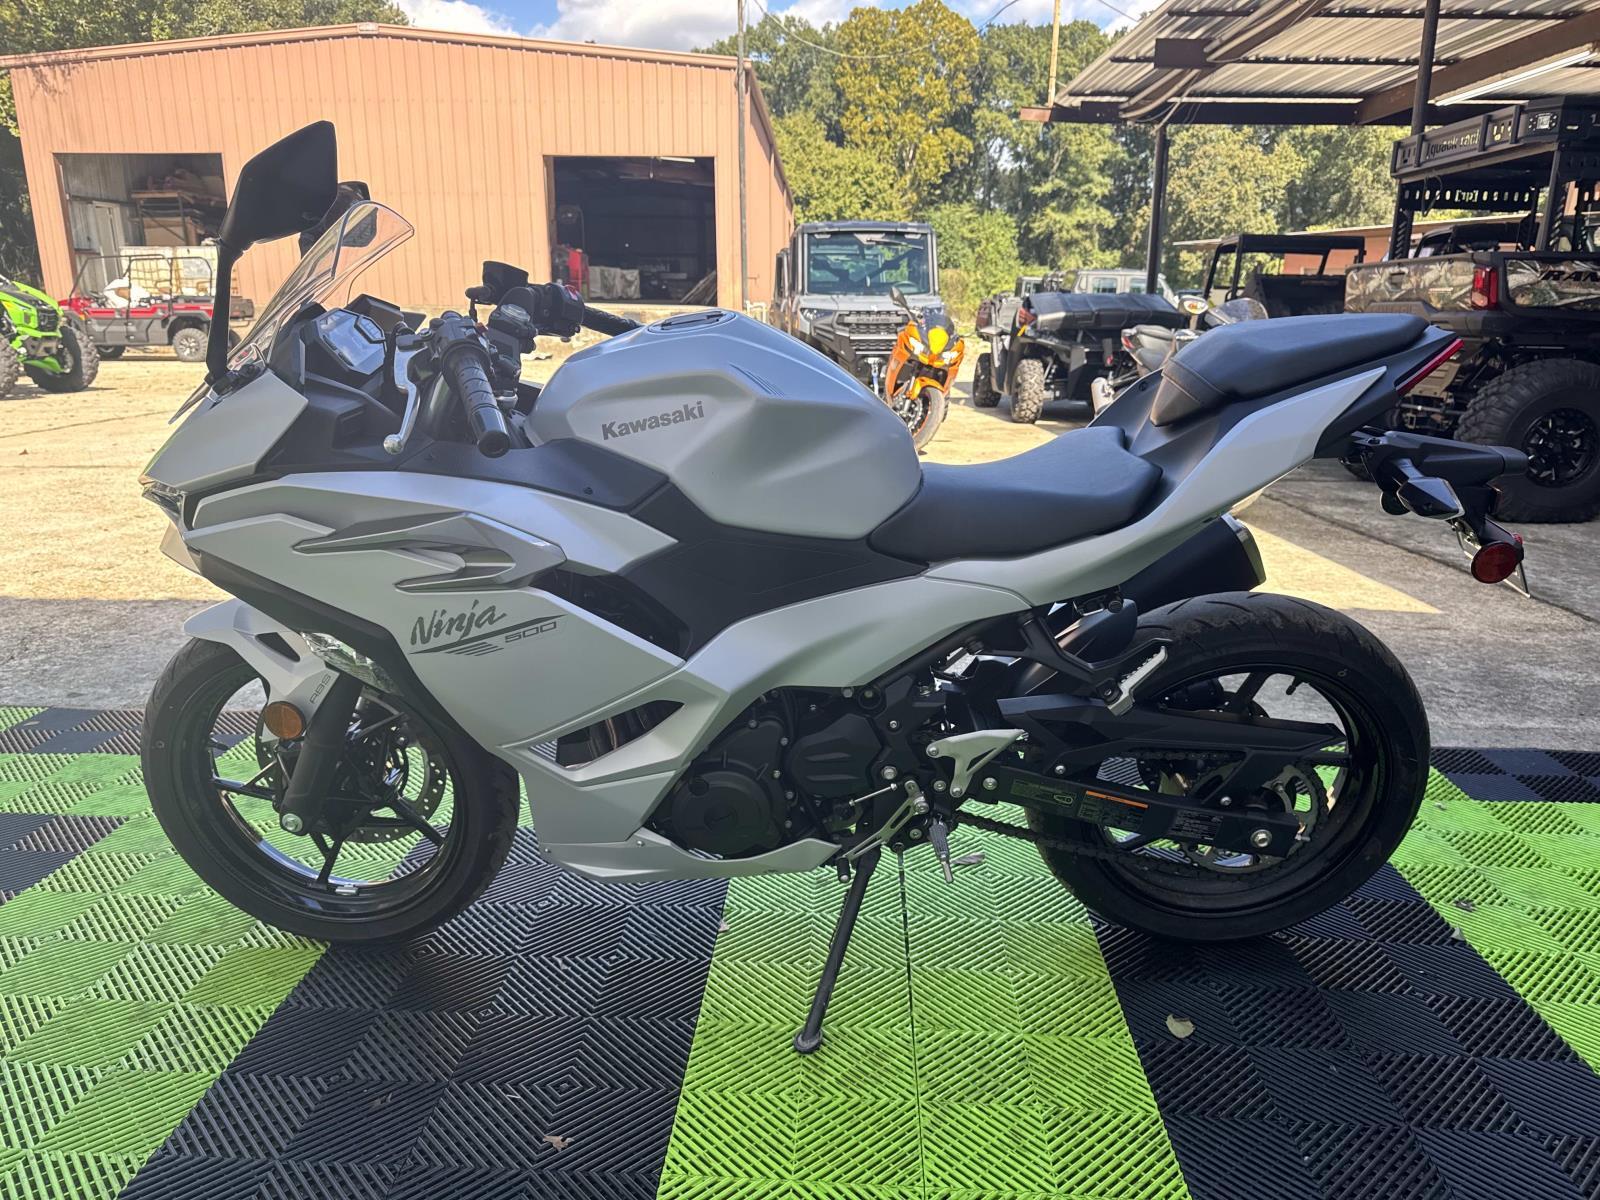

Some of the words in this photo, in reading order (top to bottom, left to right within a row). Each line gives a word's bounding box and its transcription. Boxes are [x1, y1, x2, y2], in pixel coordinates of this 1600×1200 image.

[601, 400, 705, 441] Kawasaki
[410, 599, 507, 646] Ninja
[505, 621, 557, 644] 500
[309, 673, 331, 704] ABS
